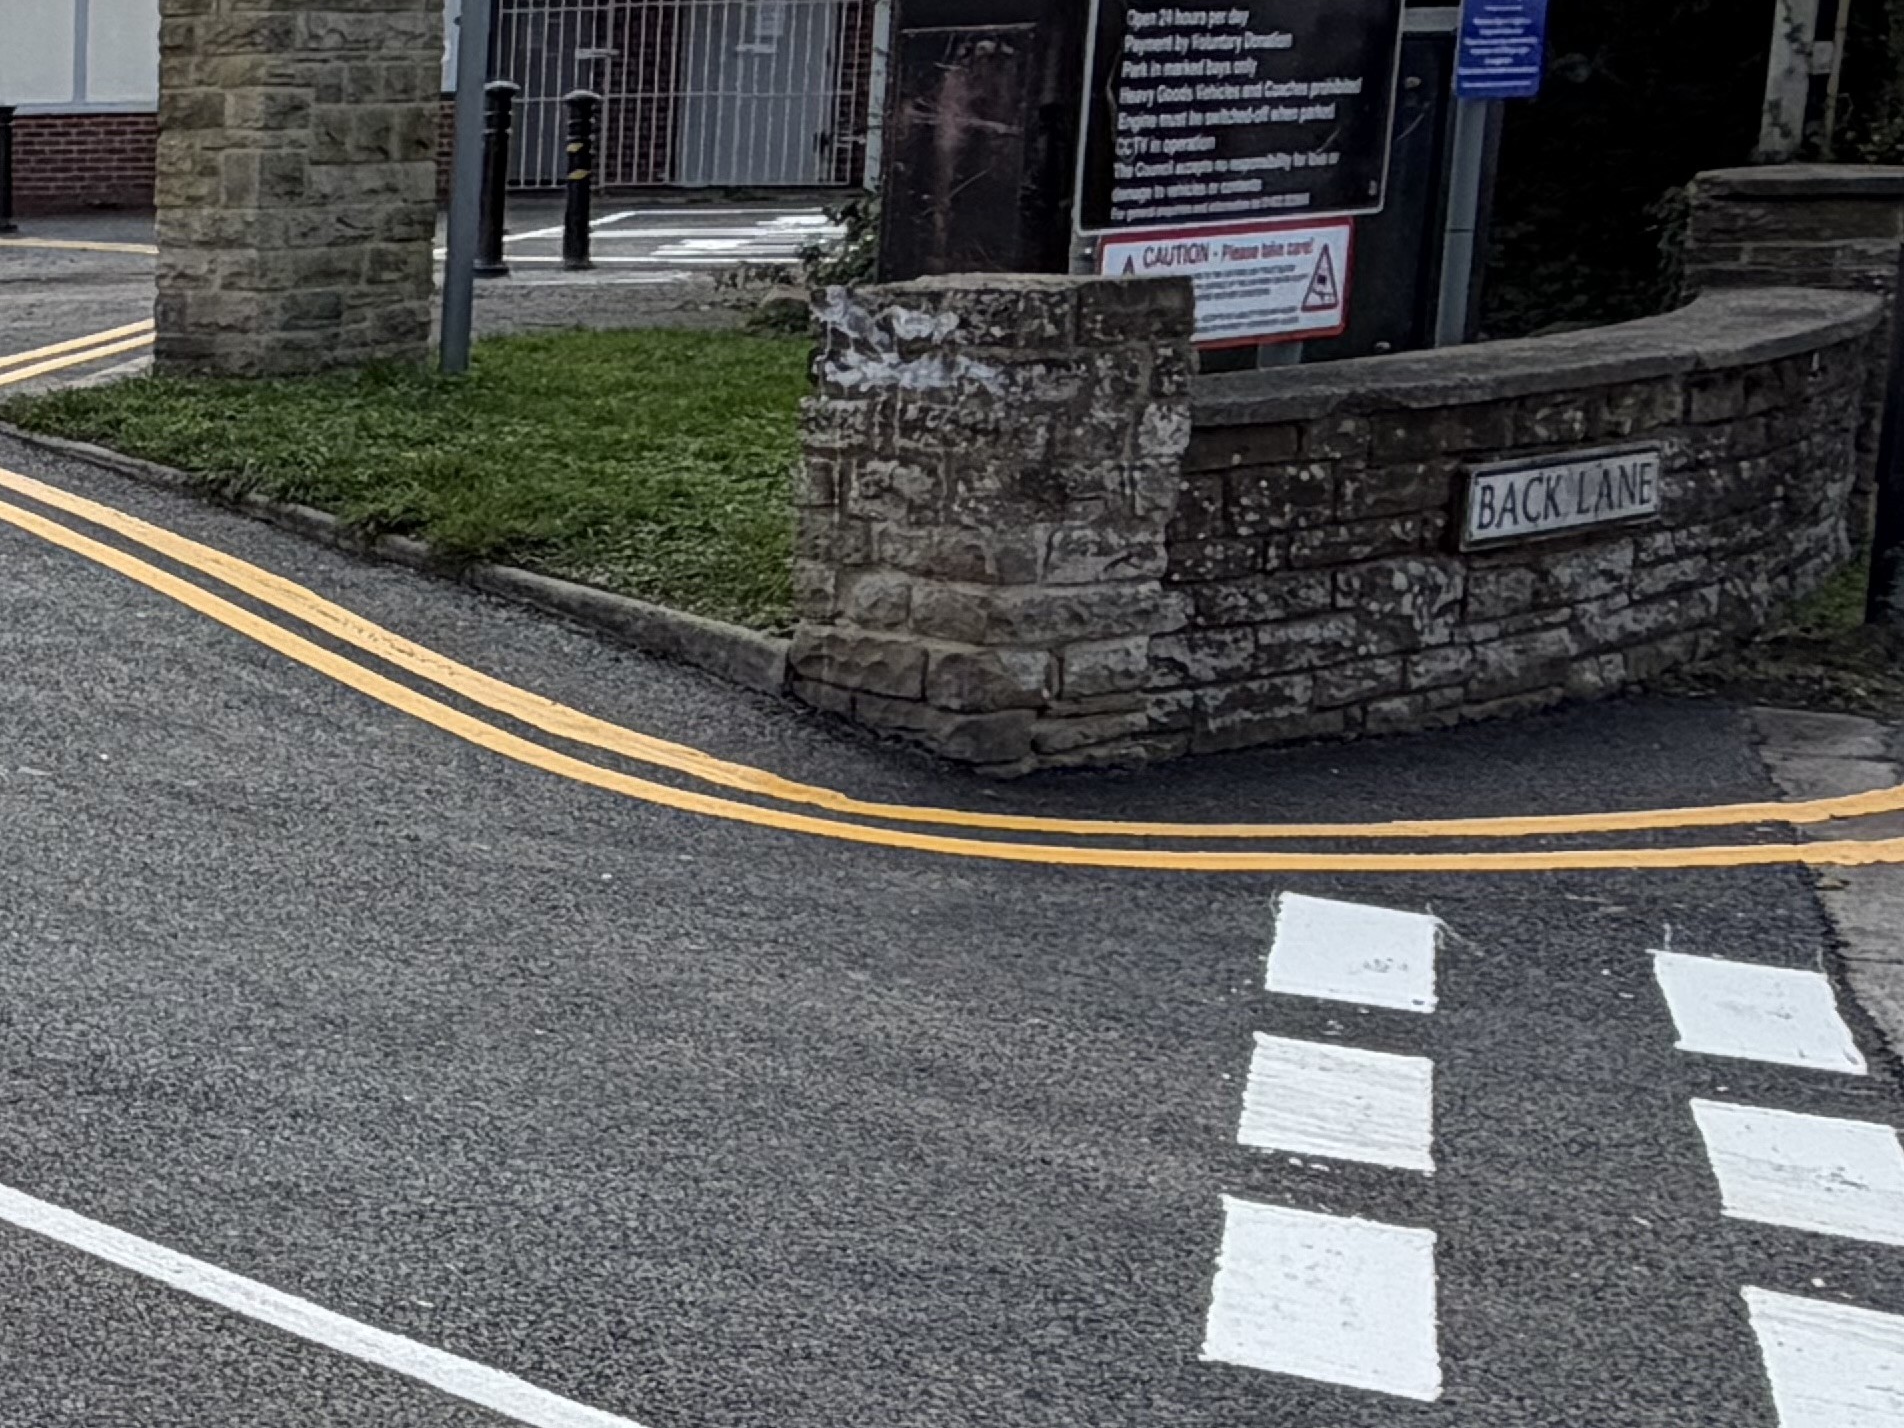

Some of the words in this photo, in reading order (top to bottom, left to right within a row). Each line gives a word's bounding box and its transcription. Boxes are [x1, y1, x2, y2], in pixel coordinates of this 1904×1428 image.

[1143, 242, 1209, 268] CAUTION
[1477, 475, 1562, 529] BACK
[1576, 462, 1653, 517] LANE
